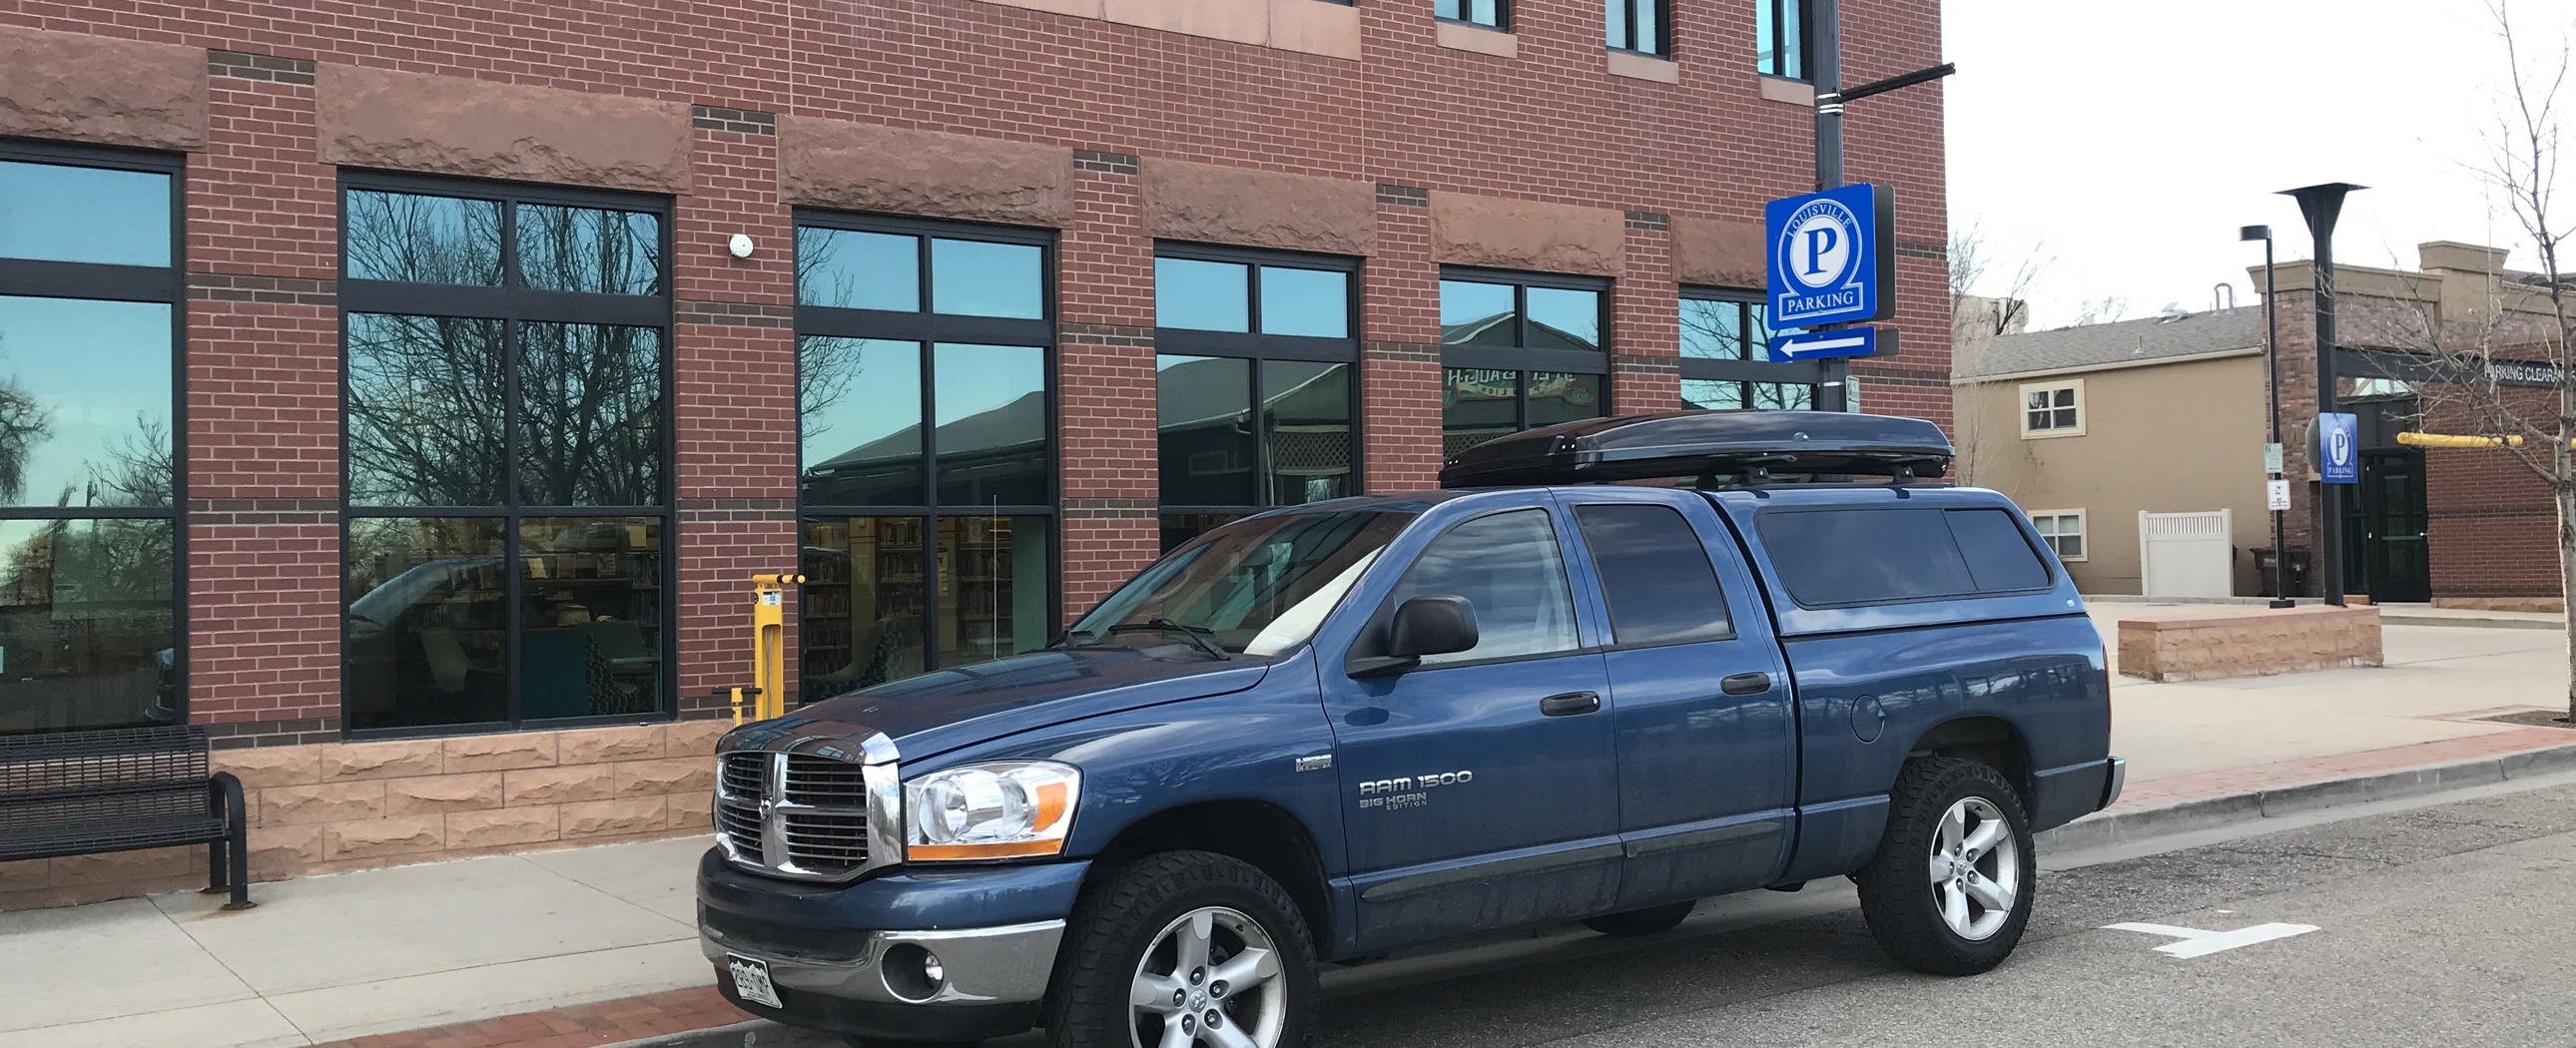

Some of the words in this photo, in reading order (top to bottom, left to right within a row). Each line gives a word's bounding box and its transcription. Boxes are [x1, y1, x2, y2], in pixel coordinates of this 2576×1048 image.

[1786, 203, 1852, 238] LOUISVILLE
[1803, 227, 1837, 276] P
[1787, 291, 1854, 312] PARKING
[2525, 366, 2575, 383] CLEARAN
[2334, 433, 2345, 460] P
[1359, 777, 1412, 795] RAM
[1417, 770, 1473, 788] 1500
[1359, 797, 1384, 808] BIG
[1386, 792, 1427, 805] HORN
[1386, 799, 1428, 810] EDITION
